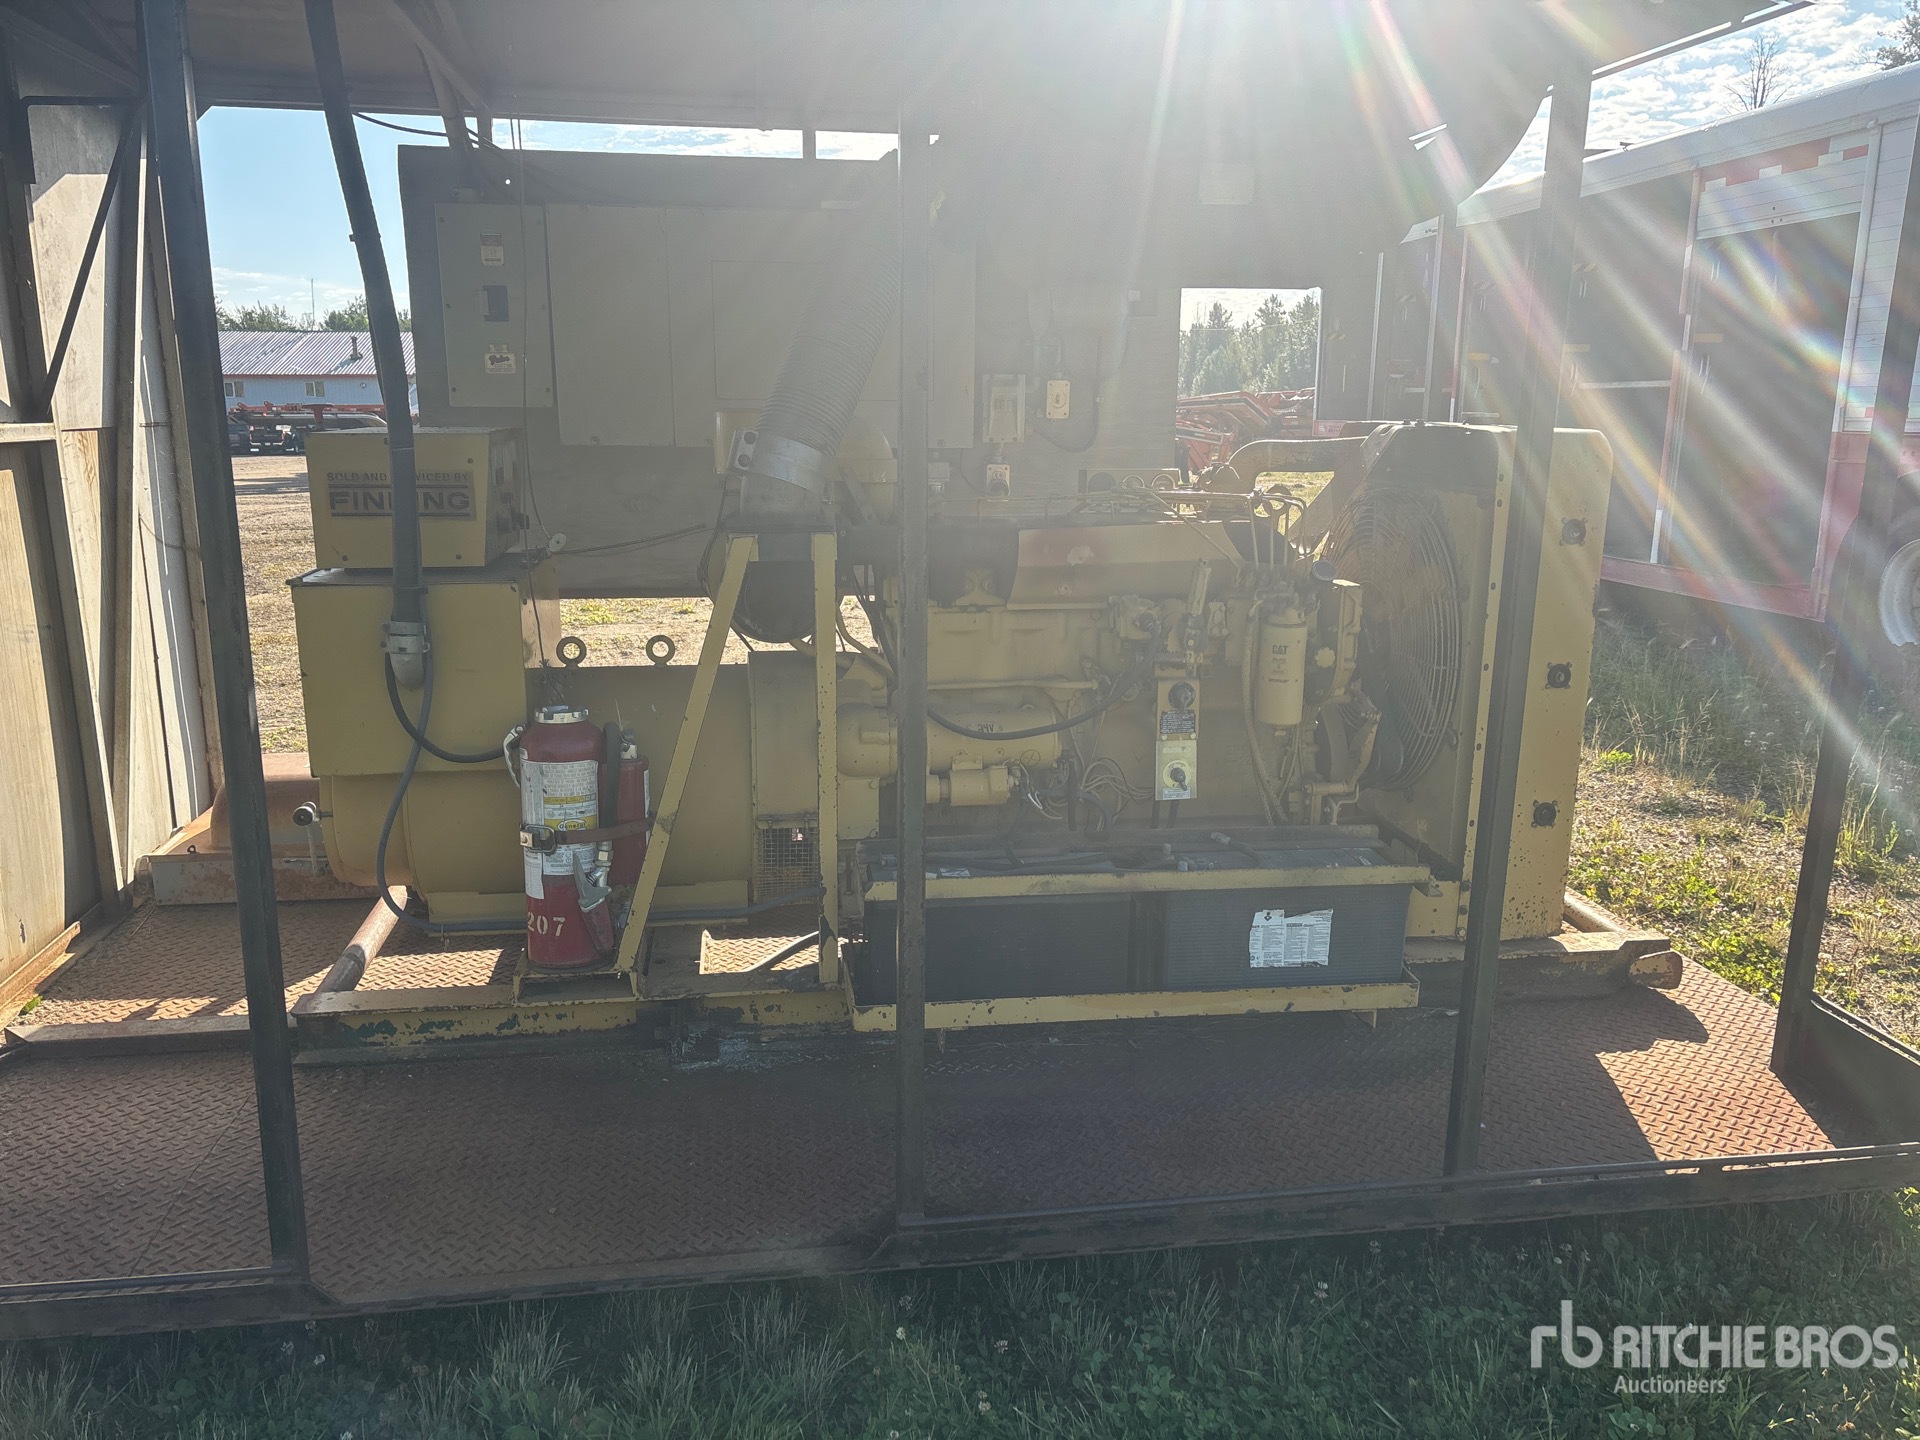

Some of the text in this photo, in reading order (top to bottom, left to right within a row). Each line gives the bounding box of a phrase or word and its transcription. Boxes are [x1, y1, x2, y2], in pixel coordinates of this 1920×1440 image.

[326, 471, 359, 482] SOLD
[362, 471, 388, 482] AND
[454, 471, 469, 482] BY
[1272, 644, 1289, 655] CAT
[527, 911, 566, 937] 207
